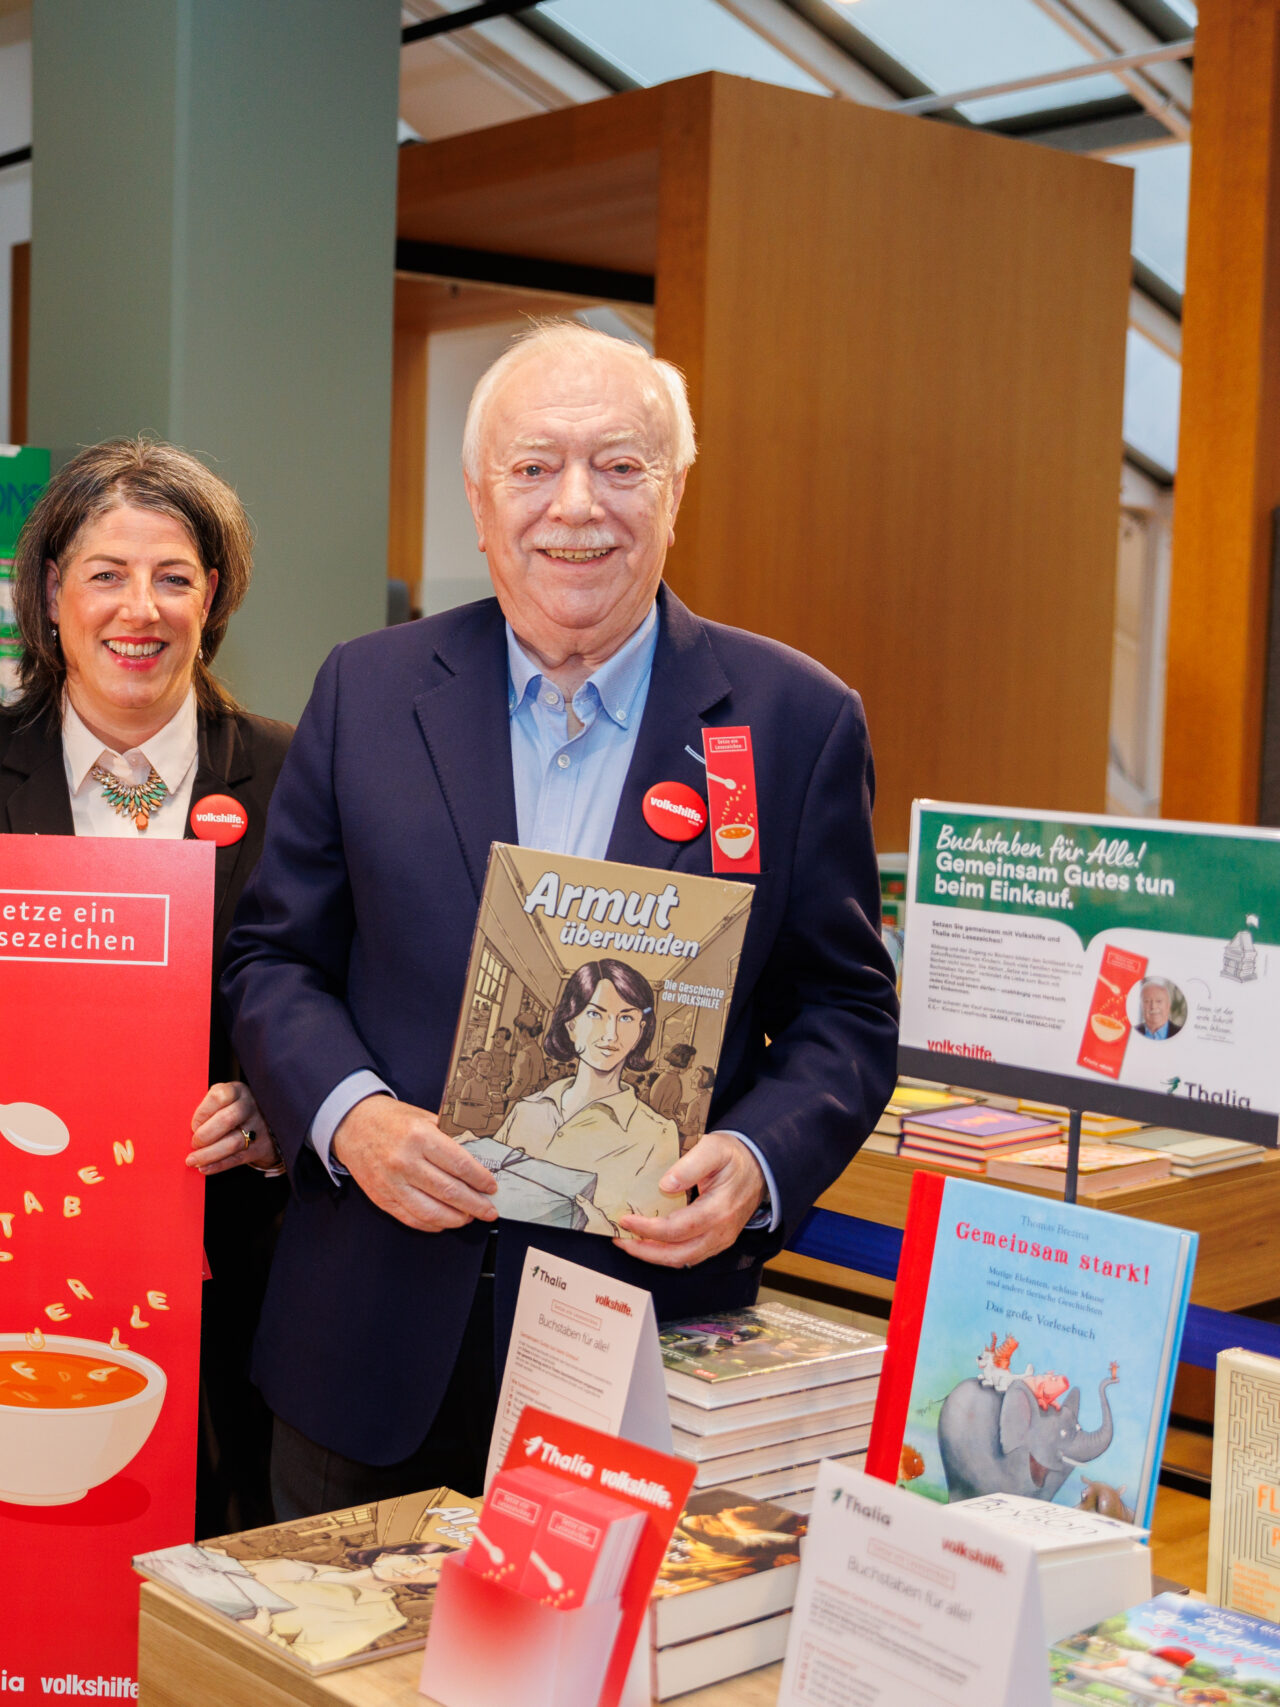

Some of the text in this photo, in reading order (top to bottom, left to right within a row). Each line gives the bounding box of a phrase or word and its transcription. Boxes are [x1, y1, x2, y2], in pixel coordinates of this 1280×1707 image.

[196, 812, 244, 825] volkshilfe.
[650, 797, 703, 823] volkshilfe.
[935, 824, 1147, 868] Buchstaben für Alle!
[935, 874, 1074, 909] beim Einkauf.
[936, 852, 1175, 896] Gemeinsam Gutes tun
[74, 902, 114, 923] ein
[523, 870, 679, 930] Armut
[559, 921, 700, 960] überwinden
[662, 990, 720, 1011] der VOLKSHILFE
[664, 979, 725, 998] Die Geschichte
[1184, 1081, 1251, 1109] Thalia
[1021, 1215, 1089, 1241] Thomas Brezina
[956, 1221, 1150, 1286] Gemeinsam stark!
[539, 1271, 567, 1290] Thalia
[595, 1294, 633, 1317] volkshilfe.
[986, 1300, 1096, 1341] Das große Vorlesebuch
[538, 1313, 581, 1342] Buchstaben
[582, 1333, 594, 1346] für
[594, 1337, 610, 1353] alle!
[540, 1442, 673, 1510] Thalia volkshilfe.
[843, 1495, 892, 1527] Thalia
[941, 1537, 1006, 1576] volkshilfe.
[847, 1555, 973, 1619] Buchstaben für alle!
